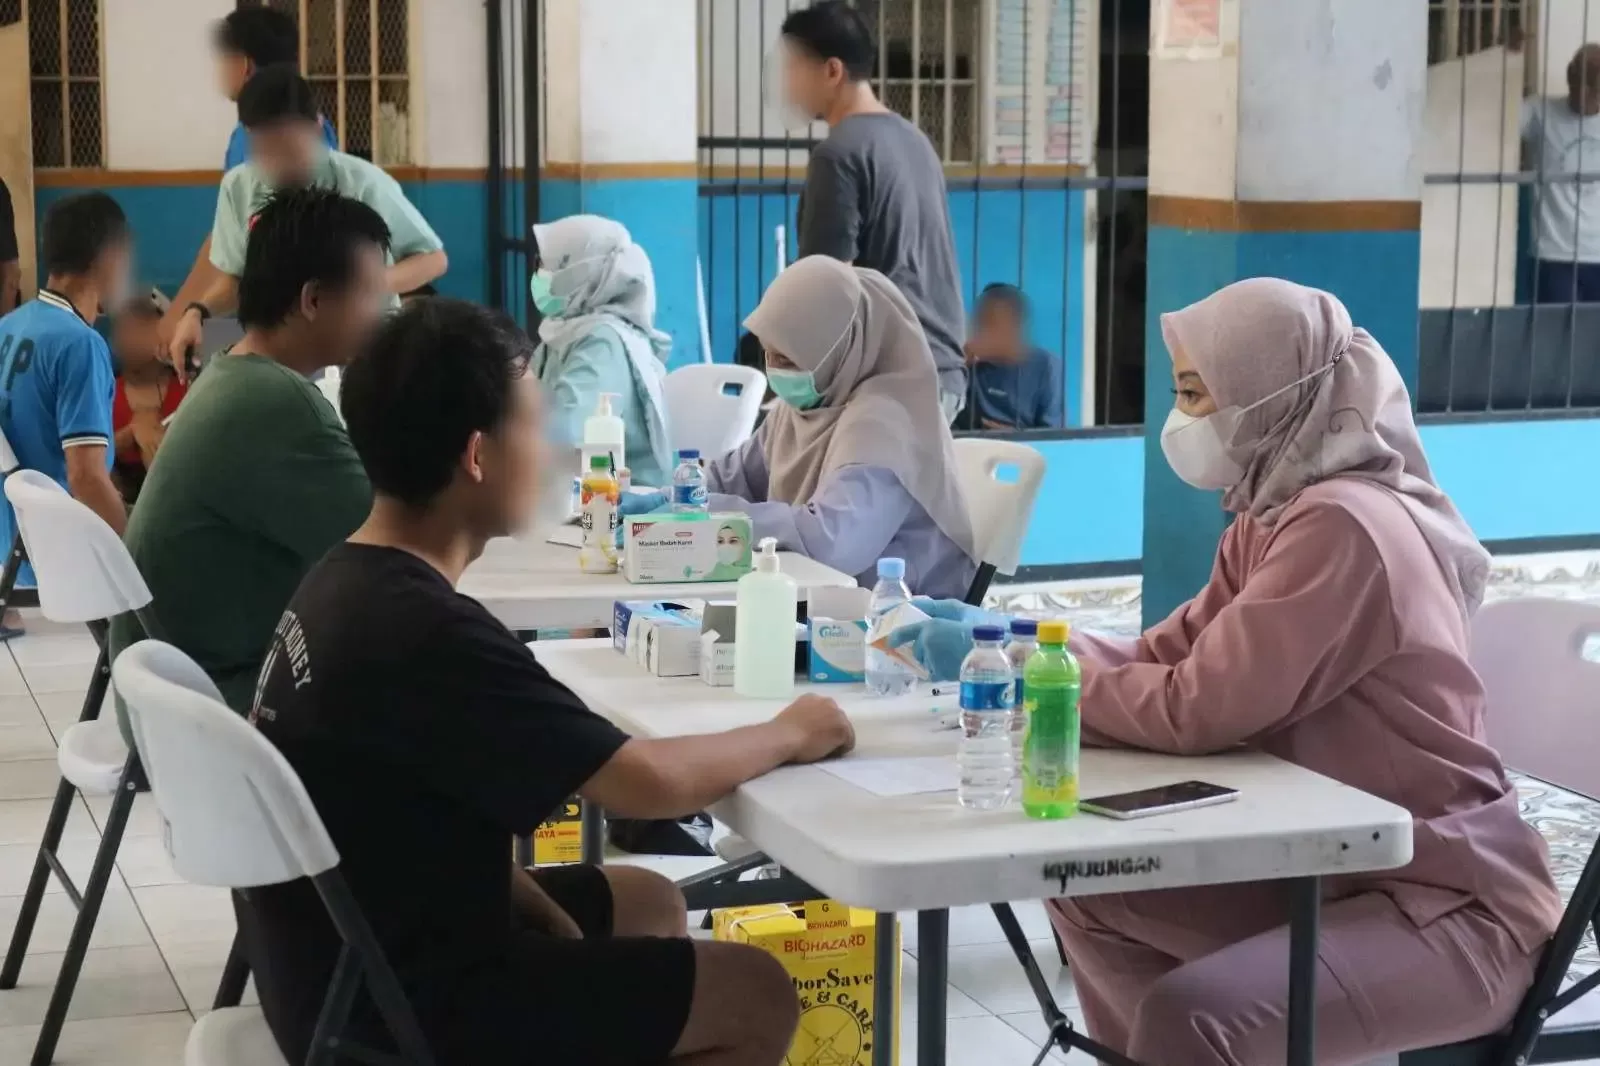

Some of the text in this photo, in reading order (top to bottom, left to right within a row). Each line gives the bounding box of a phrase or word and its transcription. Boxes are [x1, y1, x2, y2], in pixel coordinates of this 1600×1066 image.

[821, 904, 830, 912] G
[807, 919, 848, 930] BIOHAZARD
[784, 934, 866, 953] BIOHAZARD
[817, 991, 831, 1003] &
[836, 993, 873, 1034] CARE
